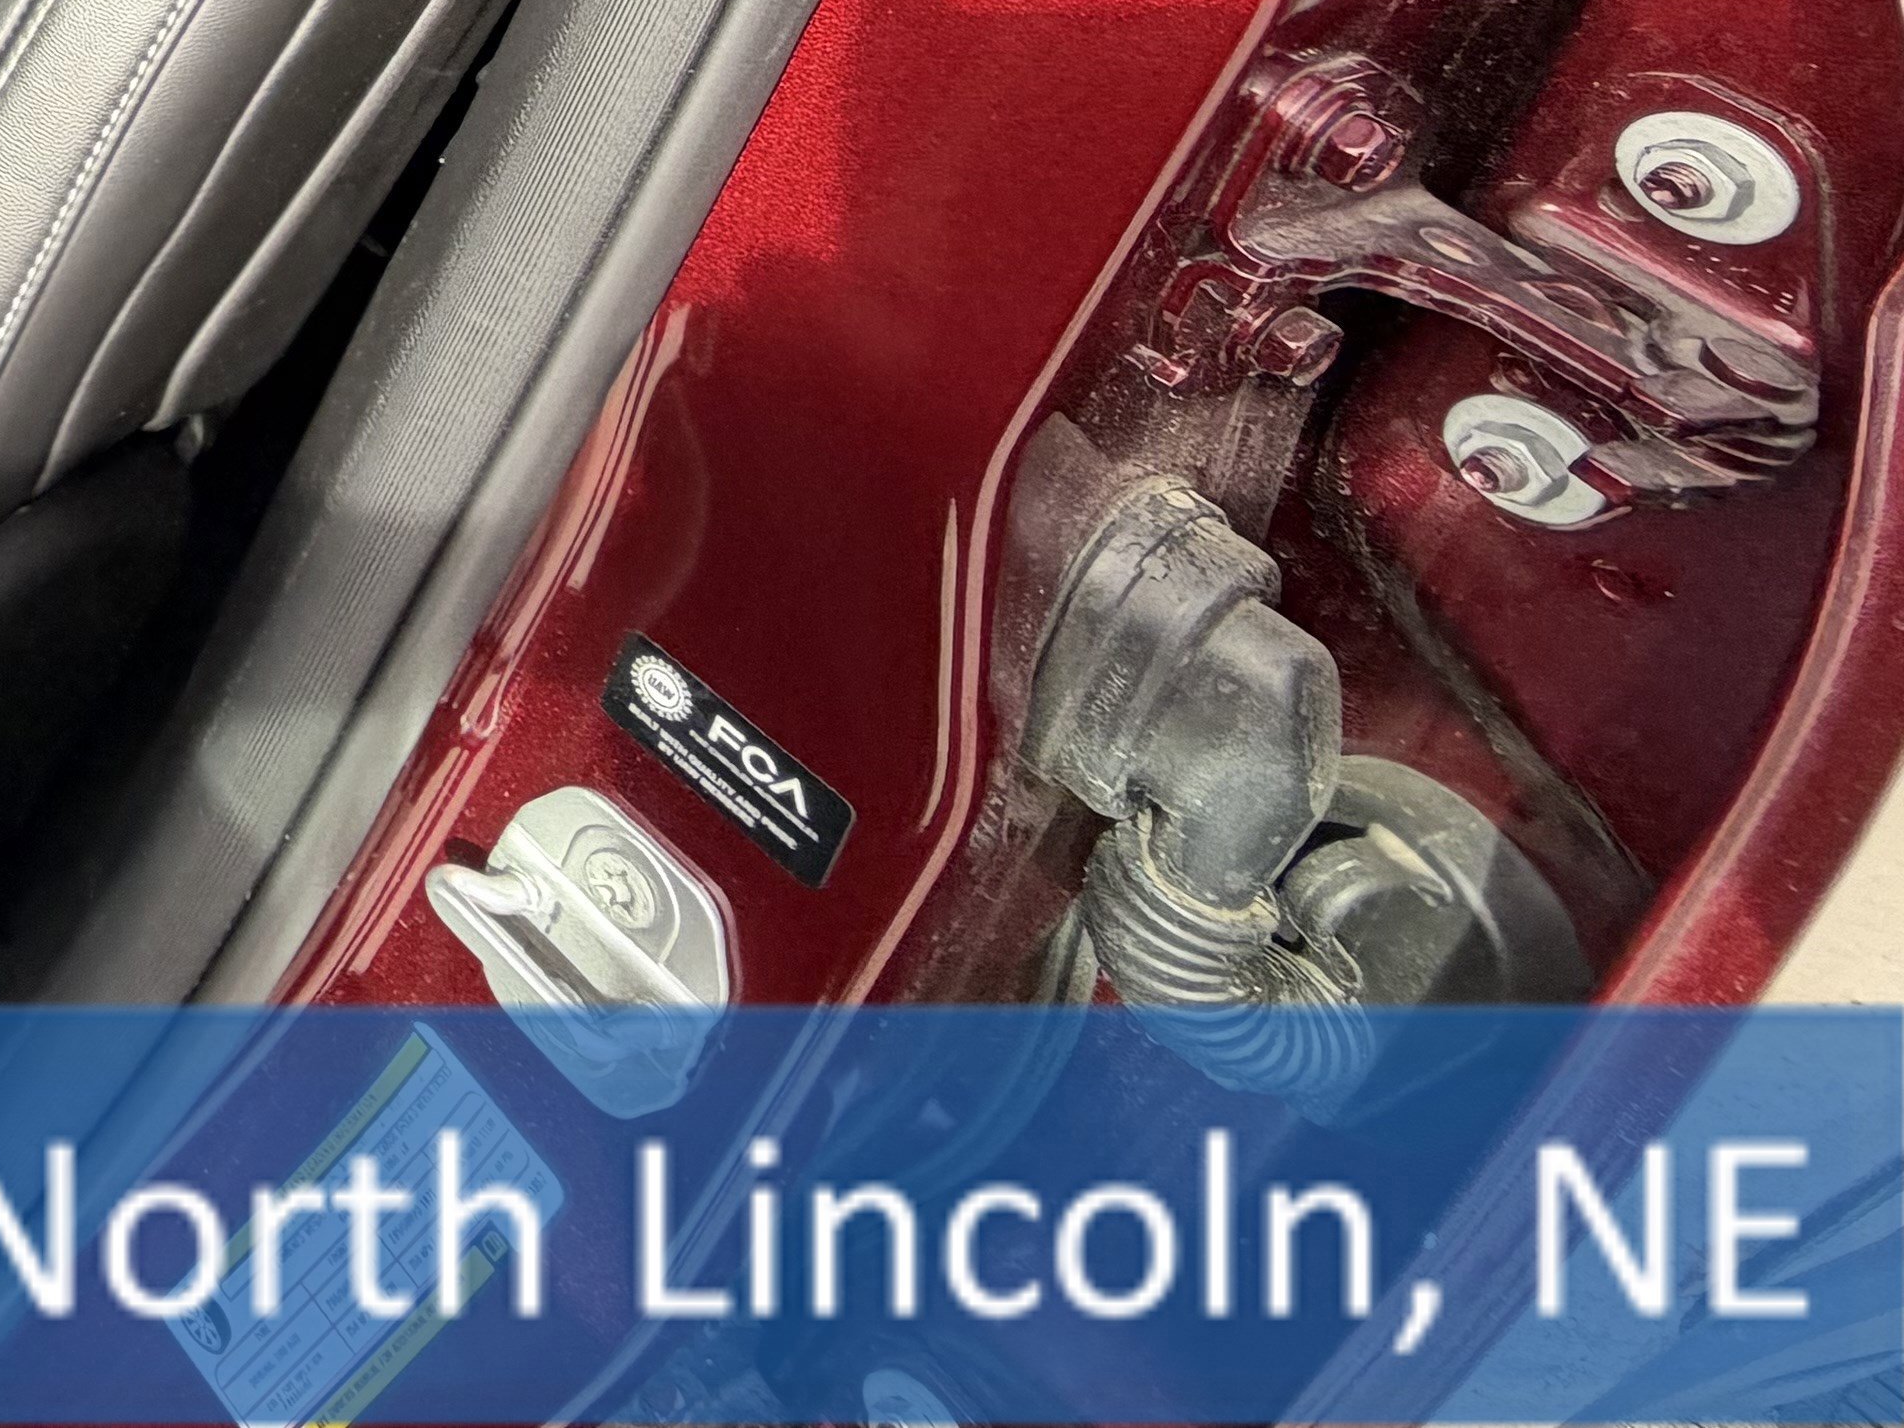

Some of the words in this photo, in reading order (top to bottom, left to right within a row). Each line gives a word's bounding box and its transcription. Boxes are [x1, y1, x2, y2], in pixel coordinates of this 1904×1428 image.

[647, 674, 676, 701] UAW
[687, 753, 737, 796] QUALITY
[708, 714, 809, 819] FCA
